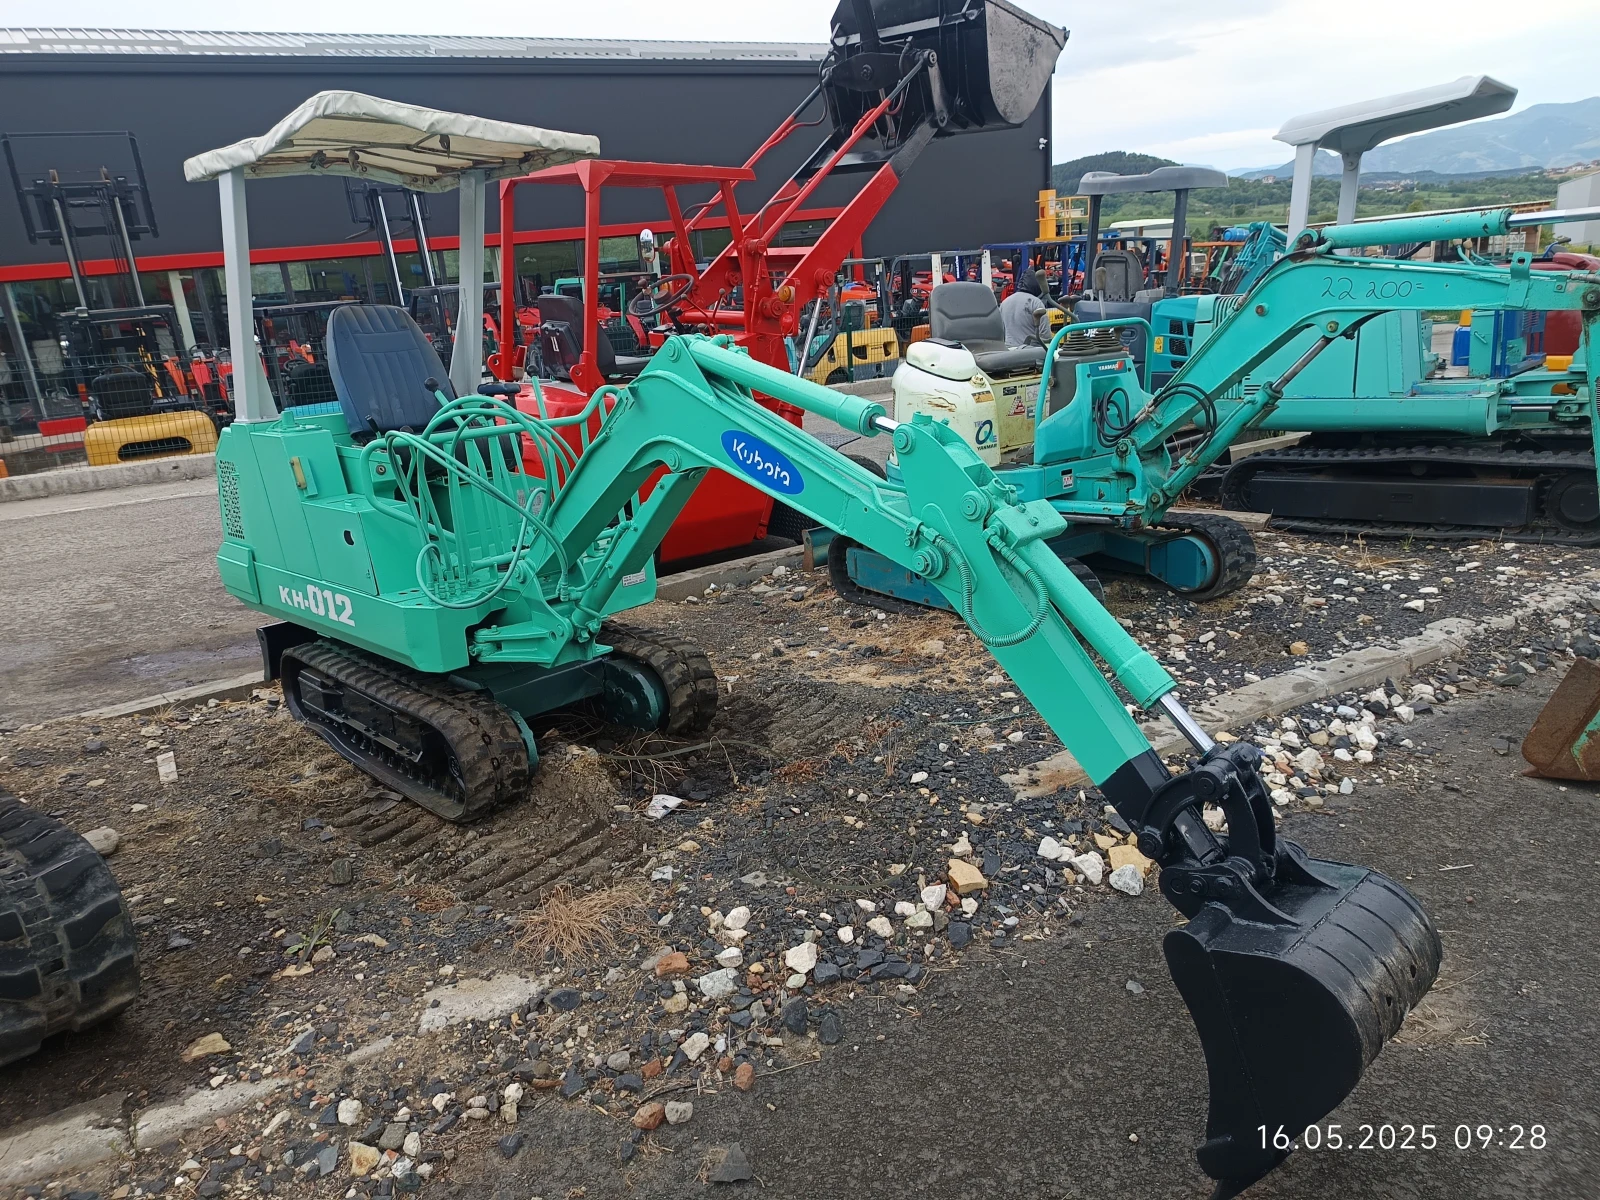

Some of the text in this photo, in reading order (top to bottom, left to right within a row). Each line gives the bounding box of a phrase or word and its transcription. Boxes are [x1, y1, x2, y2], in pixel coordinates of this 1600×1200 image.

[1321, 276, 1356, 300] 22
[732, 438, 791, 487] Kubota
[278, 584, 356, 628] KH-012
